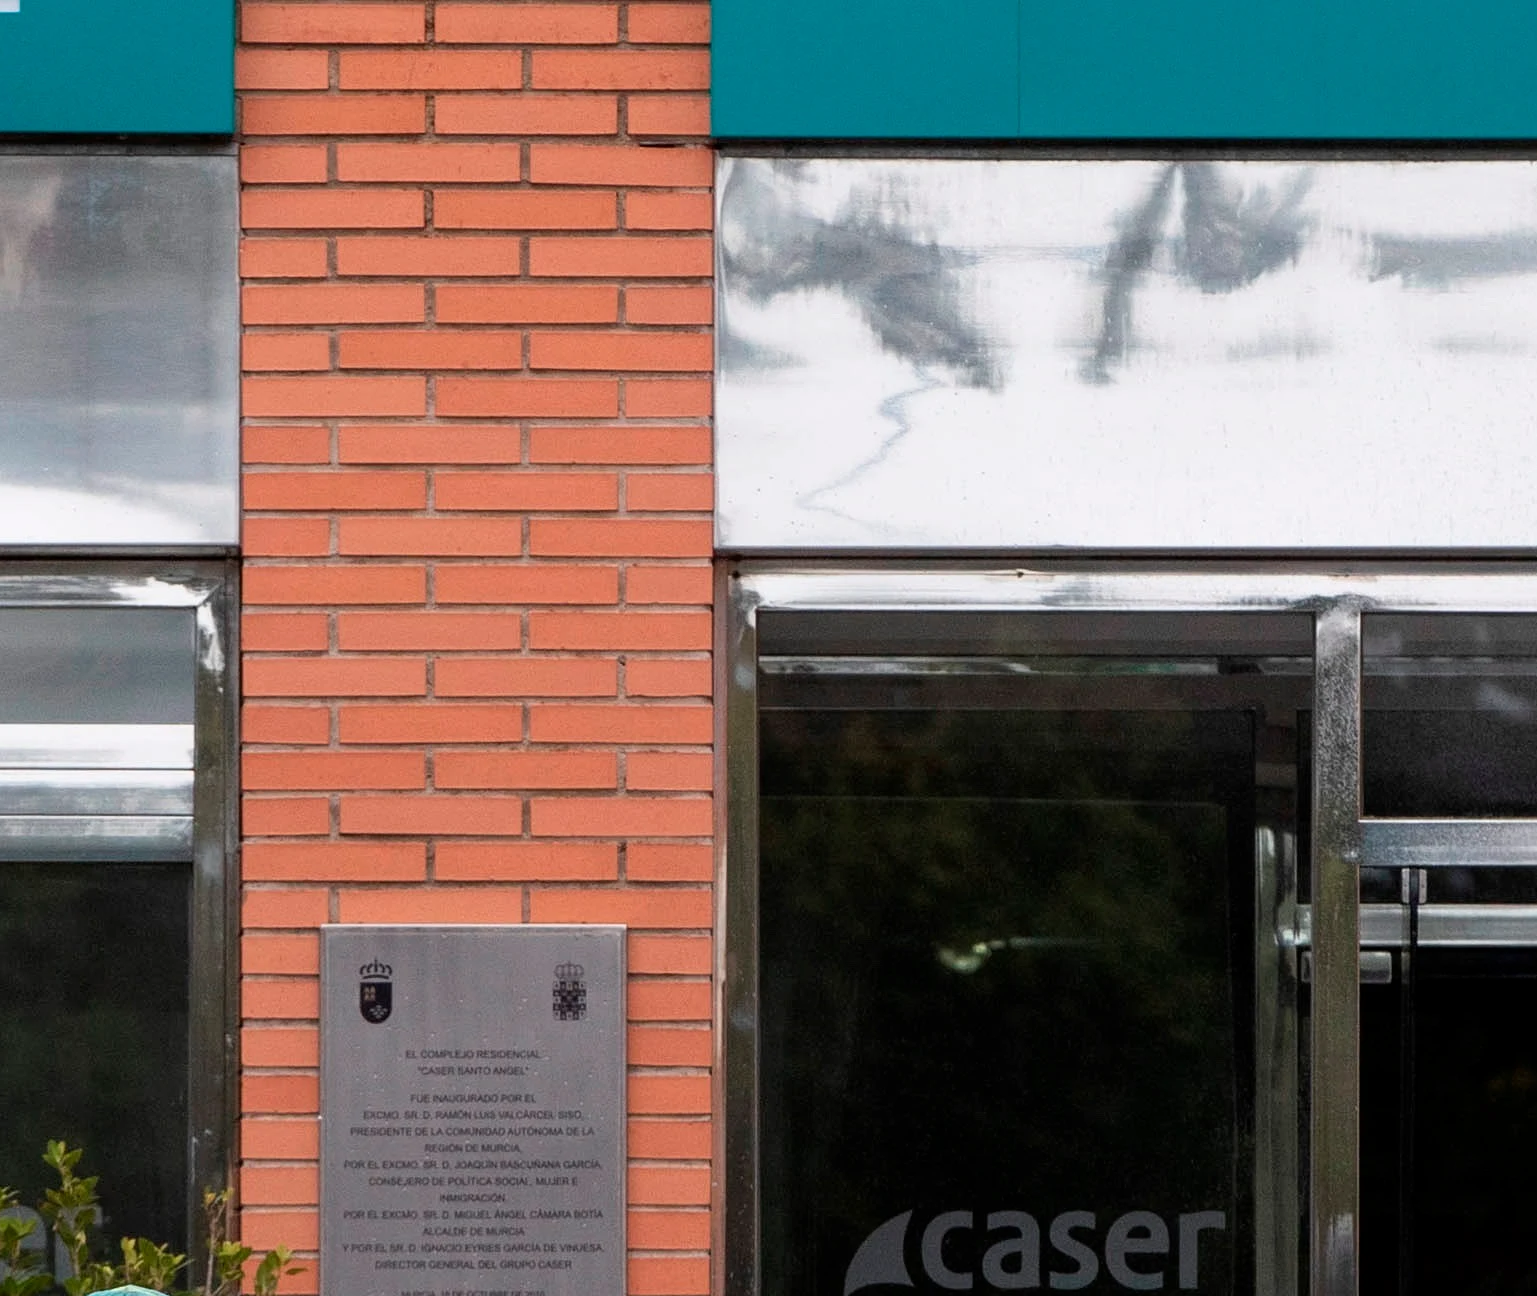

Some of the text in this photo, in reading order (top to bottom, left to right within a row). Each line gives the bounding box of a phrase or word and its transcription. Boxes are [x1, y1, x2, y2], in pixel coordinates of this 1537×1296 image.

[405, 1050, 541, 1059] EL COMPLEJO RESIDENCIAL
[457, 1066, 491, 1075] SANTO
[410, 1094, 537, 1103] FUE INAUGURADO POR EL
[473, 1109, 496, 1120] LUIS
[349, 1127, 595, 1136] PRESIDENTE DE LA COMUNIDAD AUTÓNOMA DE LA
[424, 1143, 464, 1153] REGIÓN
[464, 1143, 479, 1153] DE
[343, 1160, 366, 1170] POR
[367, 1160, 381, 1170] EL
[368, 1177, 429, 1186] CONSEJERO
[431, 1177, 446, 1186] DE
[447, 1177, 493, 1186] POLÍTICA
[535, 1177, 570, 1186] MUJER
[343, 1209, 365, 1220] POR
[367, 1209, 379, 1220] EL
[454, 1209, 491, 1220] MIGUEL
[422, 1227, 526, 1236] ALCALDE DE MURCIA
[341, 1243, 349, 1252] Y
[350, 1243, 373, 1252] POR
[374, 1243, 387, 1252] EL
[543, 1243, 558, 1252] DE
[921, 1210, 1226, 1290] caser
[374, 1260, 572, 1270] DIRECTOR GENERAL DEL GRUPO CASER
